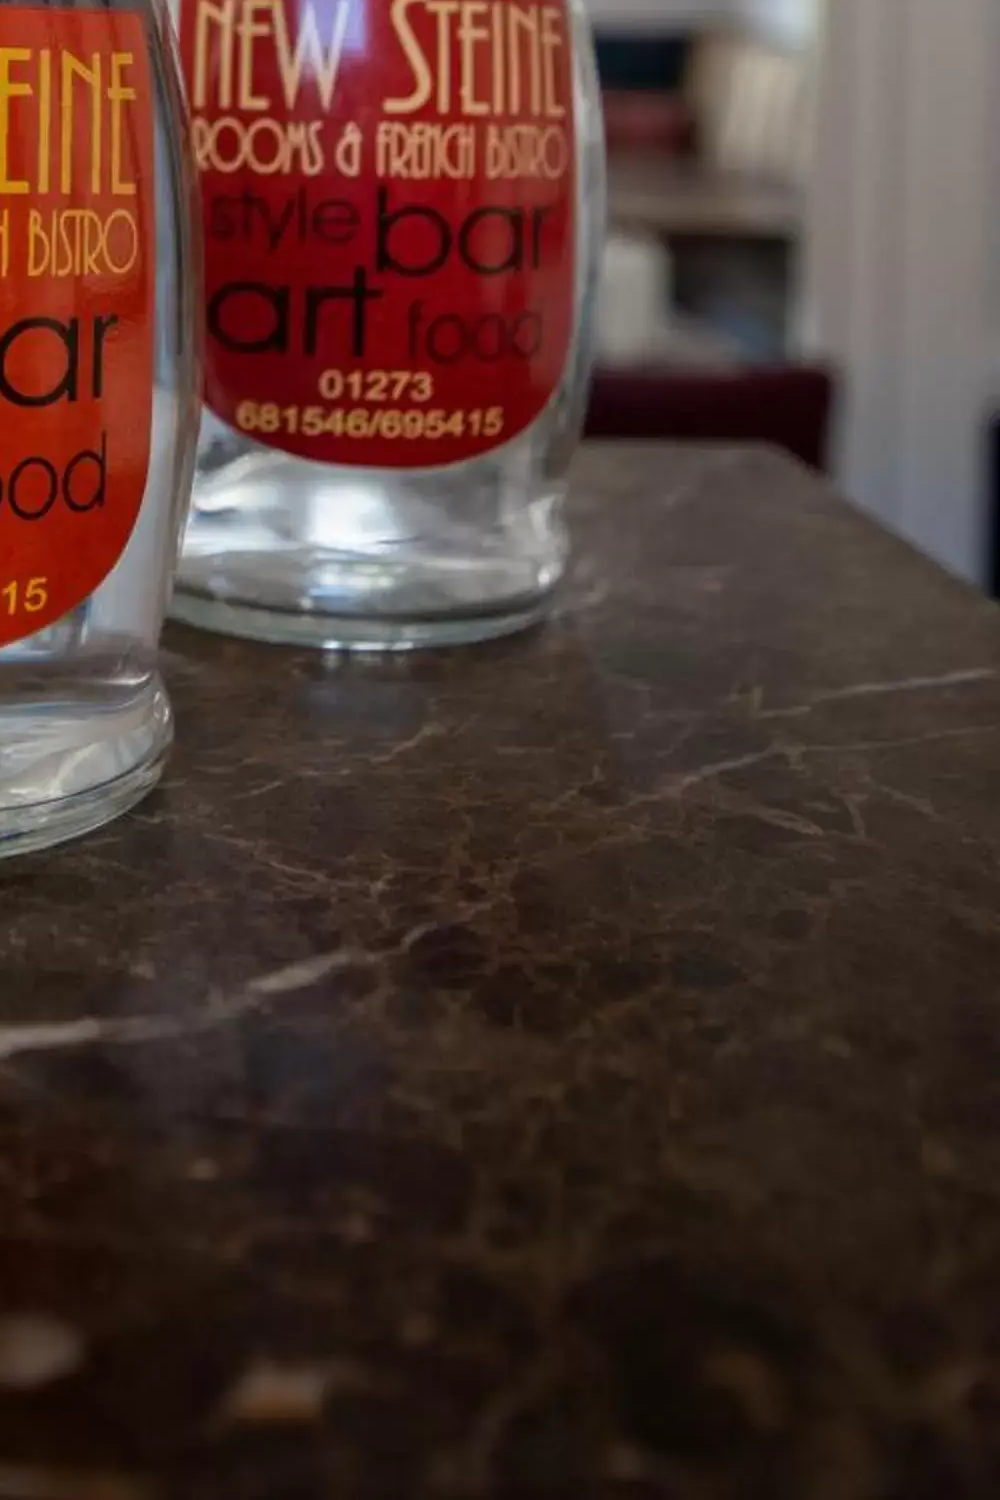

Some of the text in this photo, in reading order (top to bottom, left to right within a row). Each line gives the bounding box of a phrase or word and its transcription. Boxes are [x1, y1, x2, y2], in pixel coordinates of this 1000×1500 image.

[191, 117, 322, 176] ROOMS
[376, 121, 476, 180] FRENCH
[486, 122, 567, 180] BISTRO
[28, 208, 138, 277] BISTRO
[210, 185, 551, 278] style bar
[206, 265, 543, 365] art food
[319, 369, 433, 401] 01273
[236, 400, 504, 439] 681546/695415
